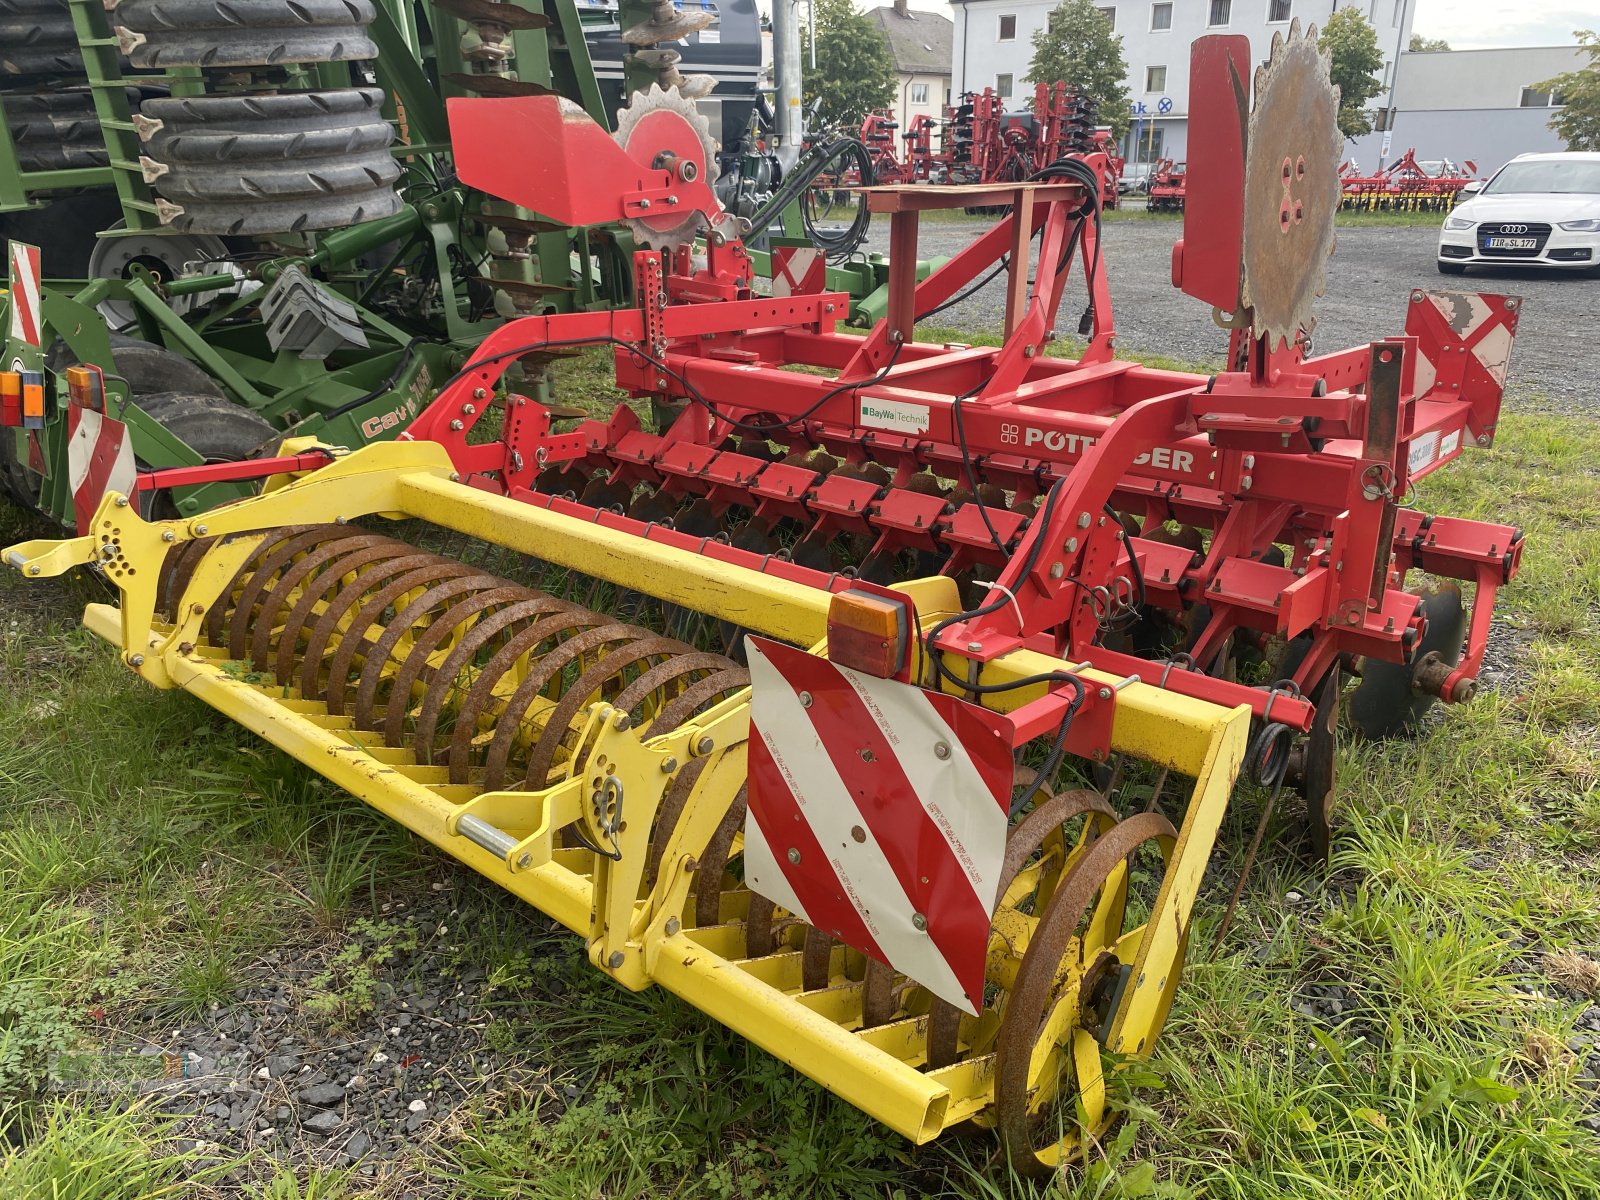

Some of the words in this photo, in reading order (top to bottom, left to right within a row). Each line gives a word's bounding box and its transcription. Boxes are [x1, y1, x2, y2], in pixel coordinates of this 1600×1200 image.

[1491, 238, 1505, 247] TIR
[1509, 239, 1519, 247] SL
[1520, 239, 1536, 248] 177
[869, 407, 895, 420] BayWa
[897, 411, 928, 426] Technik
